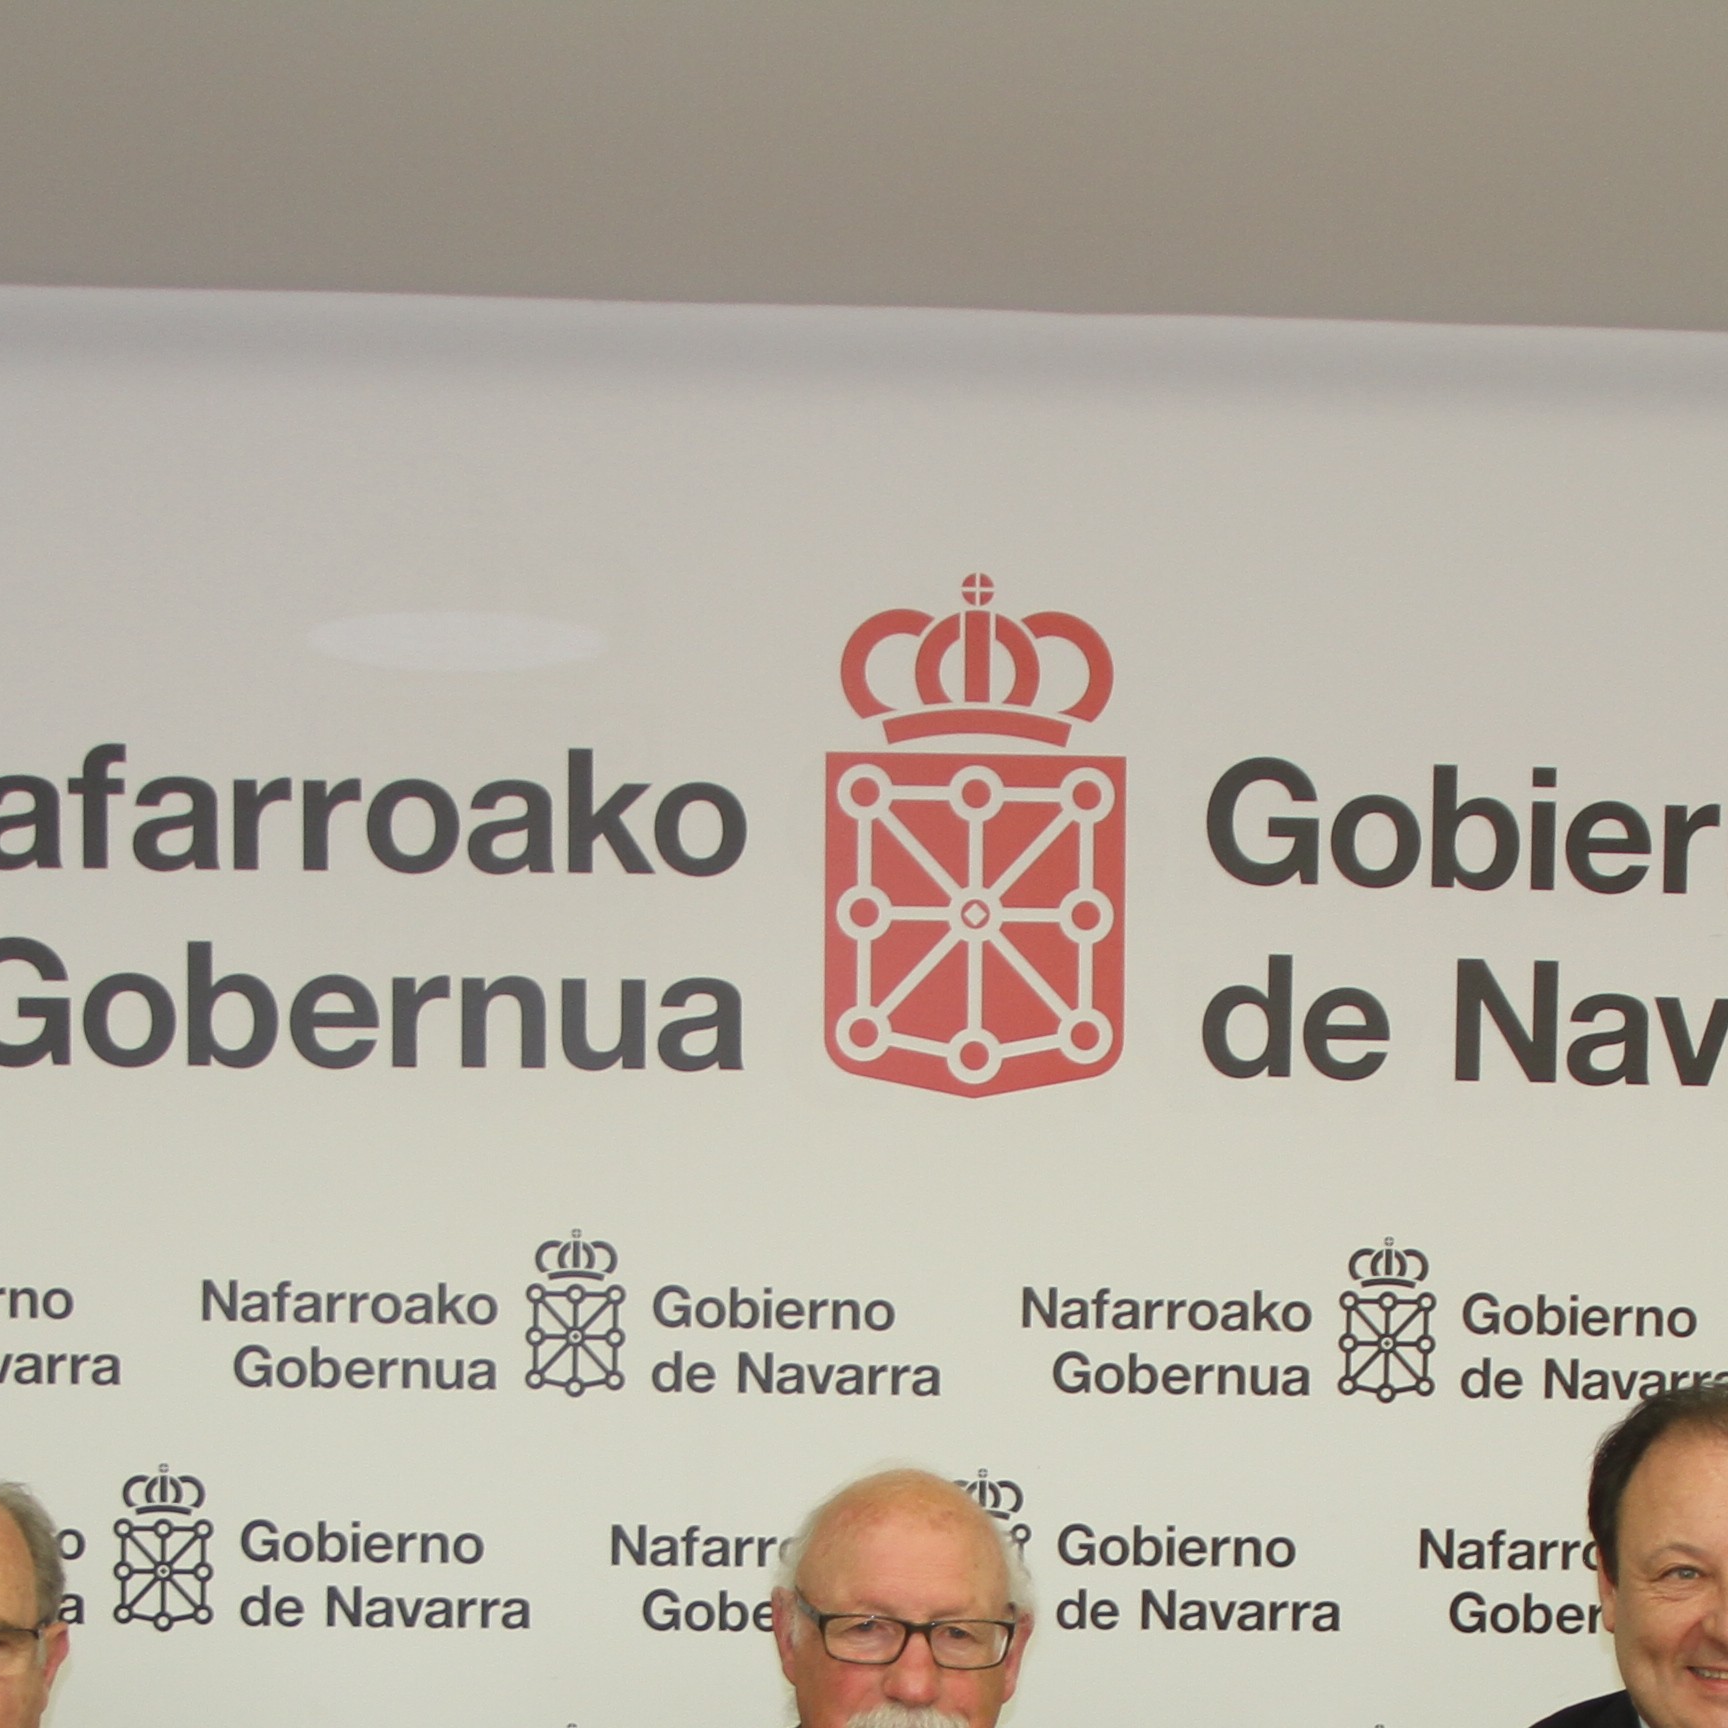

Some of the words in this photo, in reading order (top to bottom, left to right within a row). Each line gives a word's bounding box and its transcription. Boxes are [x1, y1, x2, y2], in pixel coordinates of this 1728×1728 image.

[1201, 954, 1390, 1082] de
[202, 1279, 498, 1326] Nafarroako
[652, 1284, 895, 1332] Gobierno
[1022, 1286, 1312, 1333] Nafarroako
[1462, 1292, 1697, 1338] Gobierno
[233, 1344, 496, 1391] Gobernua
[651, 1350, 716, 1394] de
[737, 1351, 940, 1397] Navarra
[1052, 1350, 1310, 1397] Gobernua
[1460, 1357, 1523, 1400] de
[240, 1519, 484, 1565] Gobierno
[611, 1524, 795, 1567] Nafarr
[1057, 1523, 1296, 1568] Gobierno
[1419, 1528, 1598, 1570] Nafarro
[239, 1585, 304, 1628] de
[326, 1585, 530, 1630] Navarra
[643, 1588, 774, 1632] Gobe
[1056, 1588, 1120, 1631] de
[1141, 1589, 1340, 1632] Navarra
[1449, 1591, 1602, 1634] Gober
